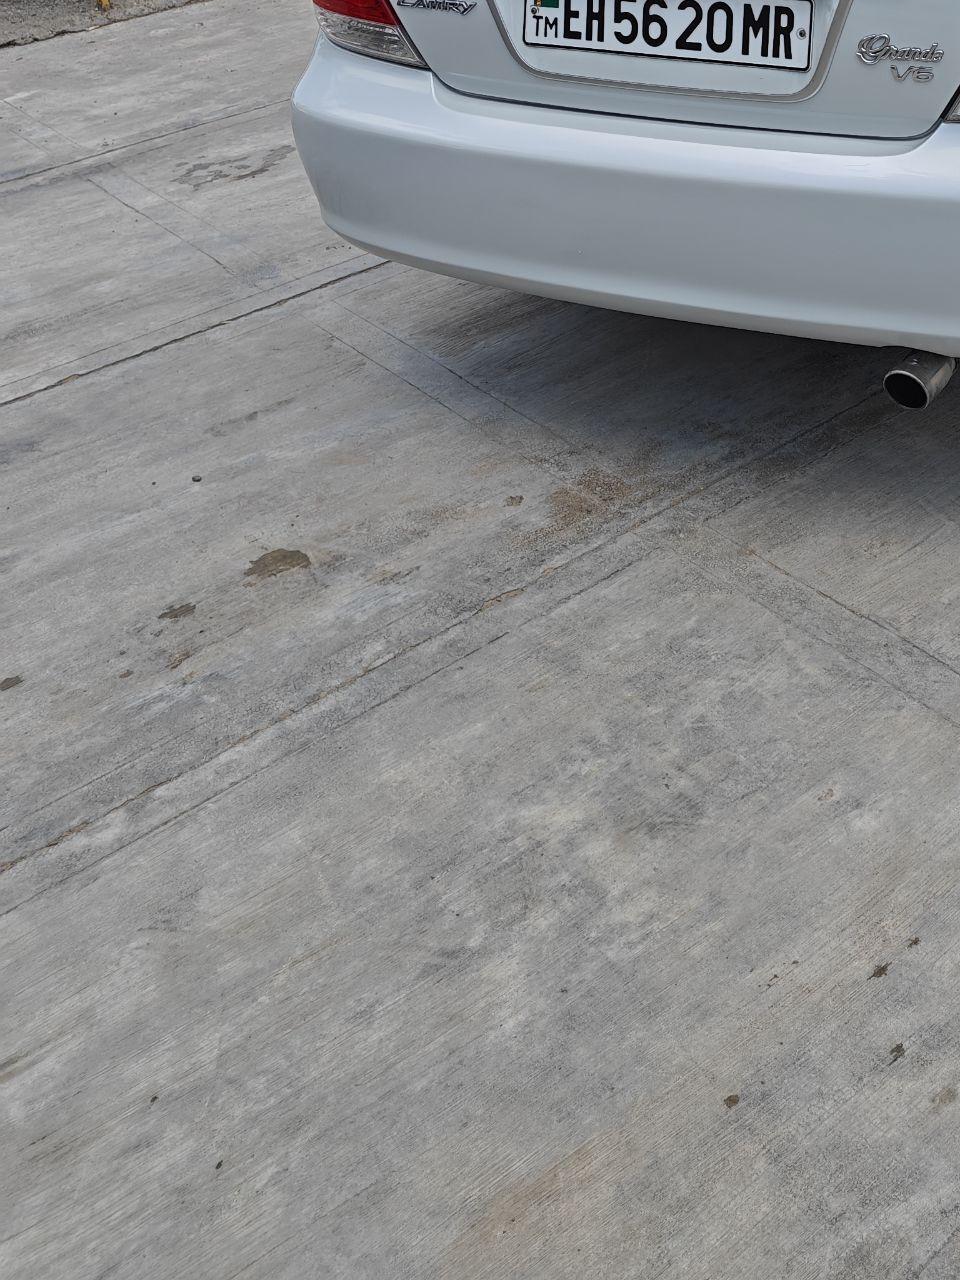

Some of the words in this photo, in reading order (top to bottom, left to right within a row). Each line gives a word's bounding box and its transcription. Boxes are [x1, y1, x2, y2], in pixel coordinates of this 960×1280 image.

[533, 15, 559, 39] TM
[856, 33, 945, 65] Grande
[890, 64, 935, 83] V6
